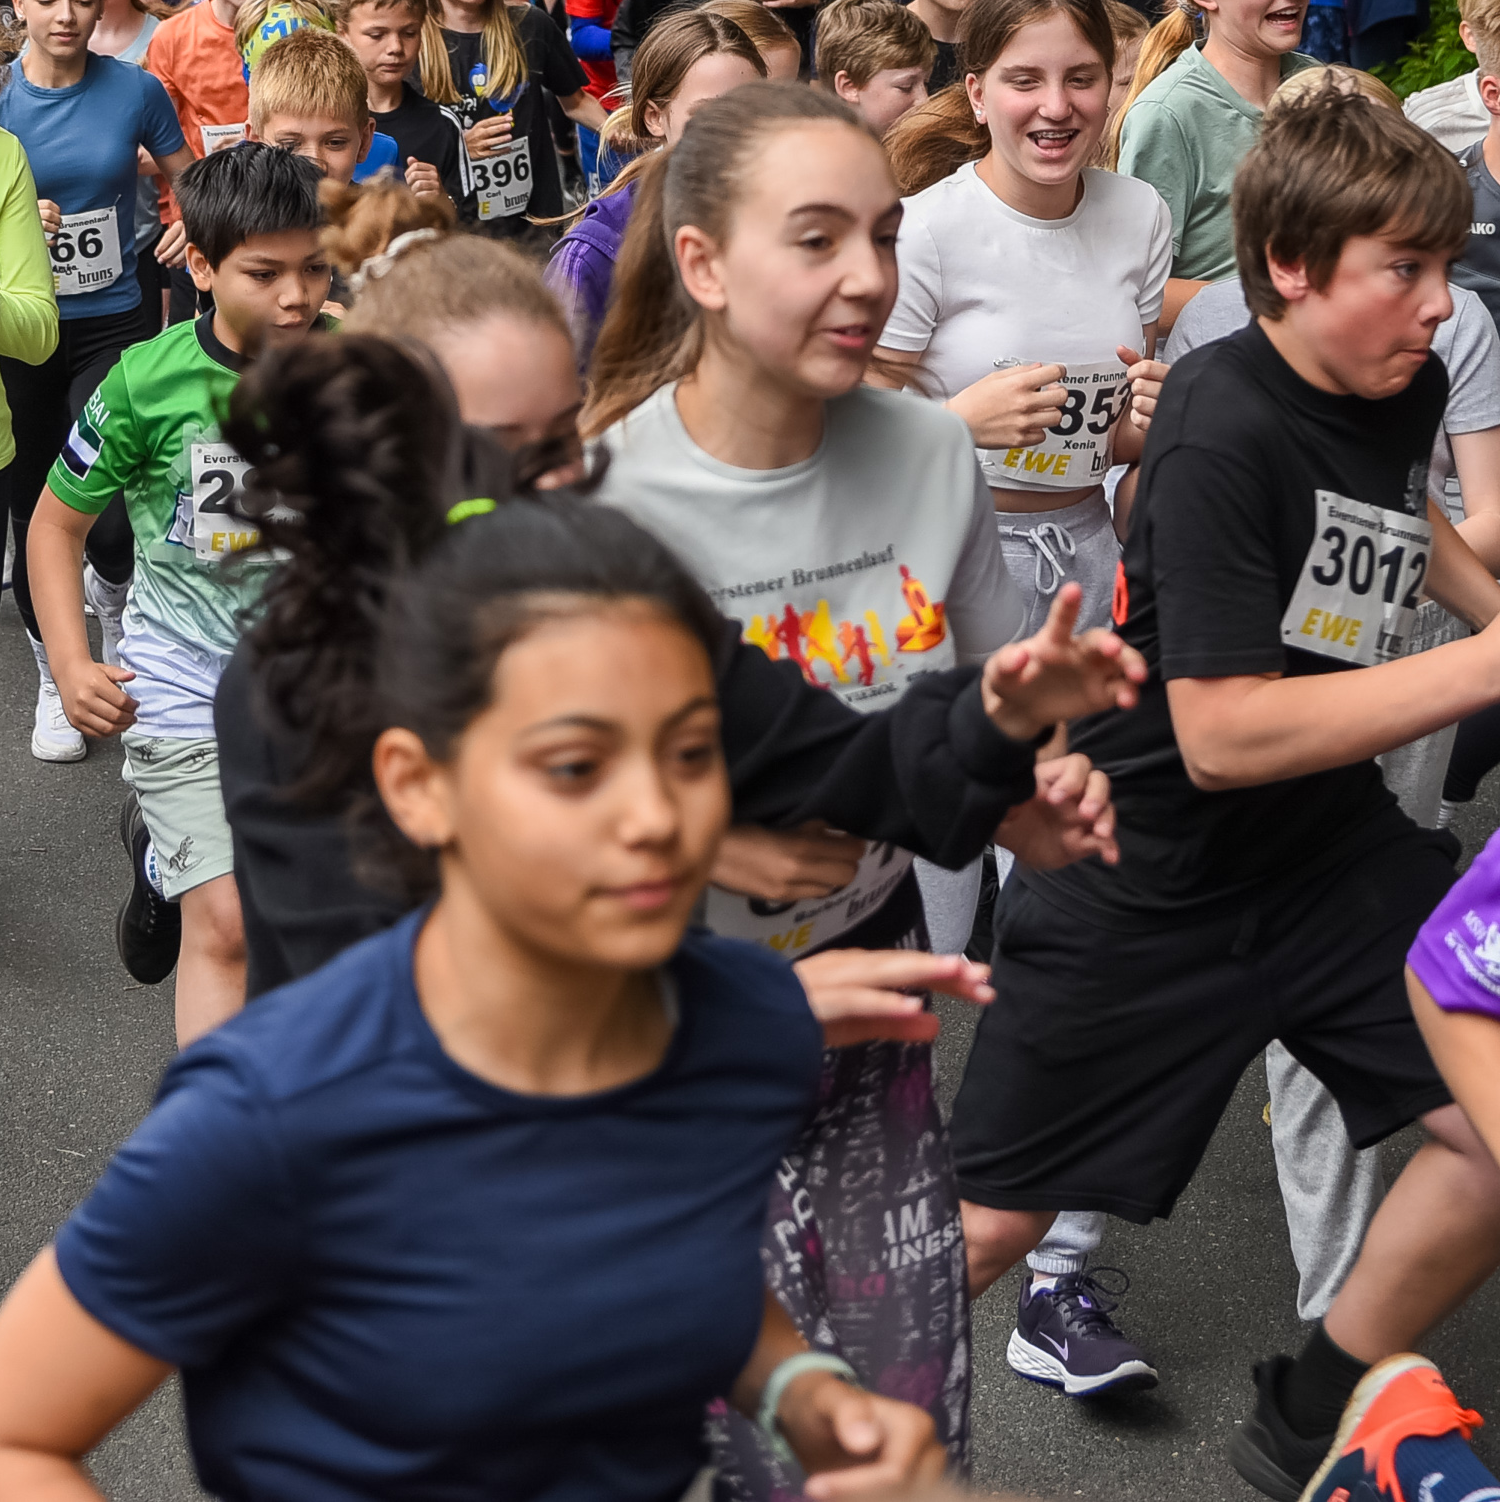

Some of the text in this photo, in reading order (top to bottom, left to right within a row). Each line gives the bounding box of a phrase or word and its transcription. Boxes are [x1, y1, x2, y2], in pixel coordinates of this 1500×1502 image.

[473, 153, 530, 191] 396
[504, 191, 530, 208] bruns
[1466, 221, 1496, 235] AKO
[50, 227, 104, 263] 66
[78, 268, 113, 285] bruns
[1062, 439, 1097, 450] Xenia
[1002, 447, 1072, 476] EWE
[790, 543, 896, 588] Brunnenlauf
[1311, 525, 1428, 610] 3012
[1300, 607, 1364, 649] EWE
